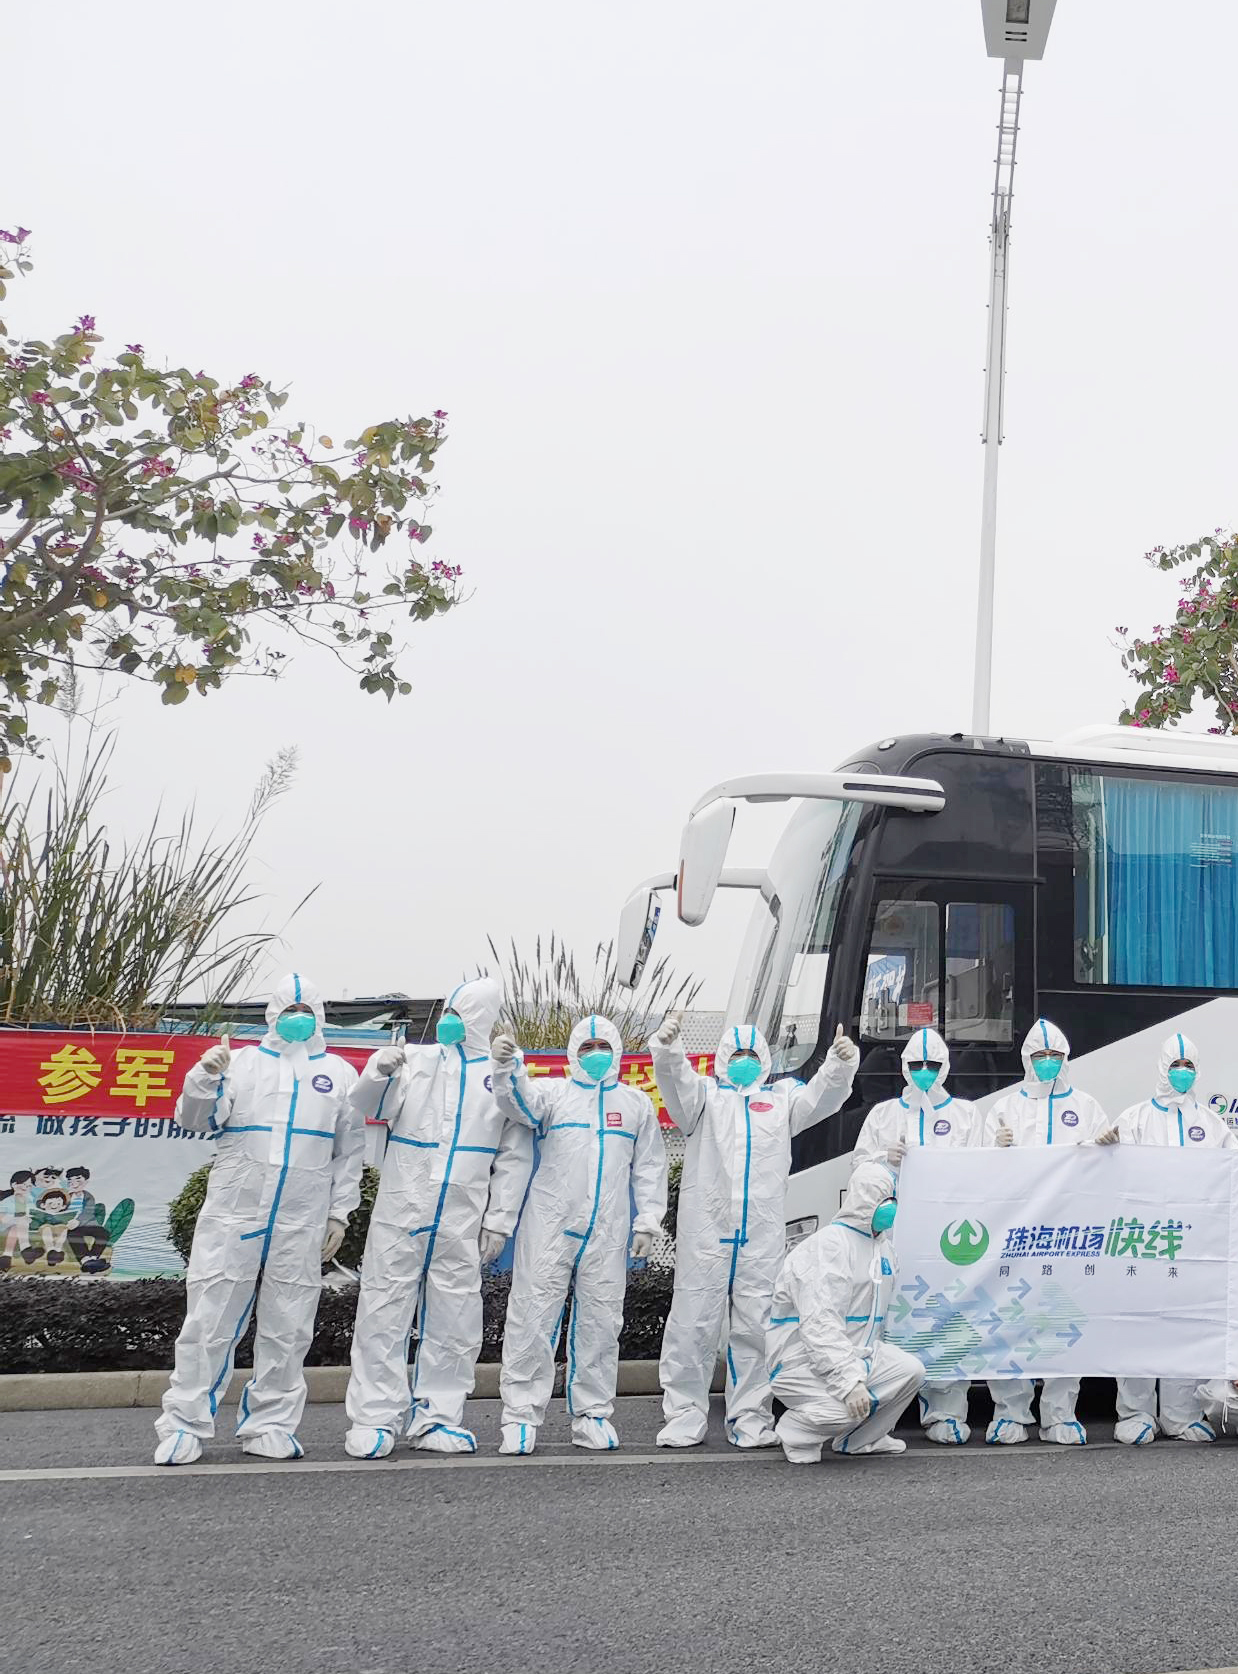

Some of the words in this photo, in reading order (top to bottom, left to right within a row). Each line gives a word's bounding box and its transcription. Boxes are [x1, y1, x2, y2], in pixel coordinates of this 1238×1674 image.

[37, 1043, 175, 1107] 参军
[36, 1115, 219, 1141] 做孩子的
[1001, 1217, 1184, 1260] 珠海机场快线
[1066, 1250, 1100, 1258] EXPRESS
